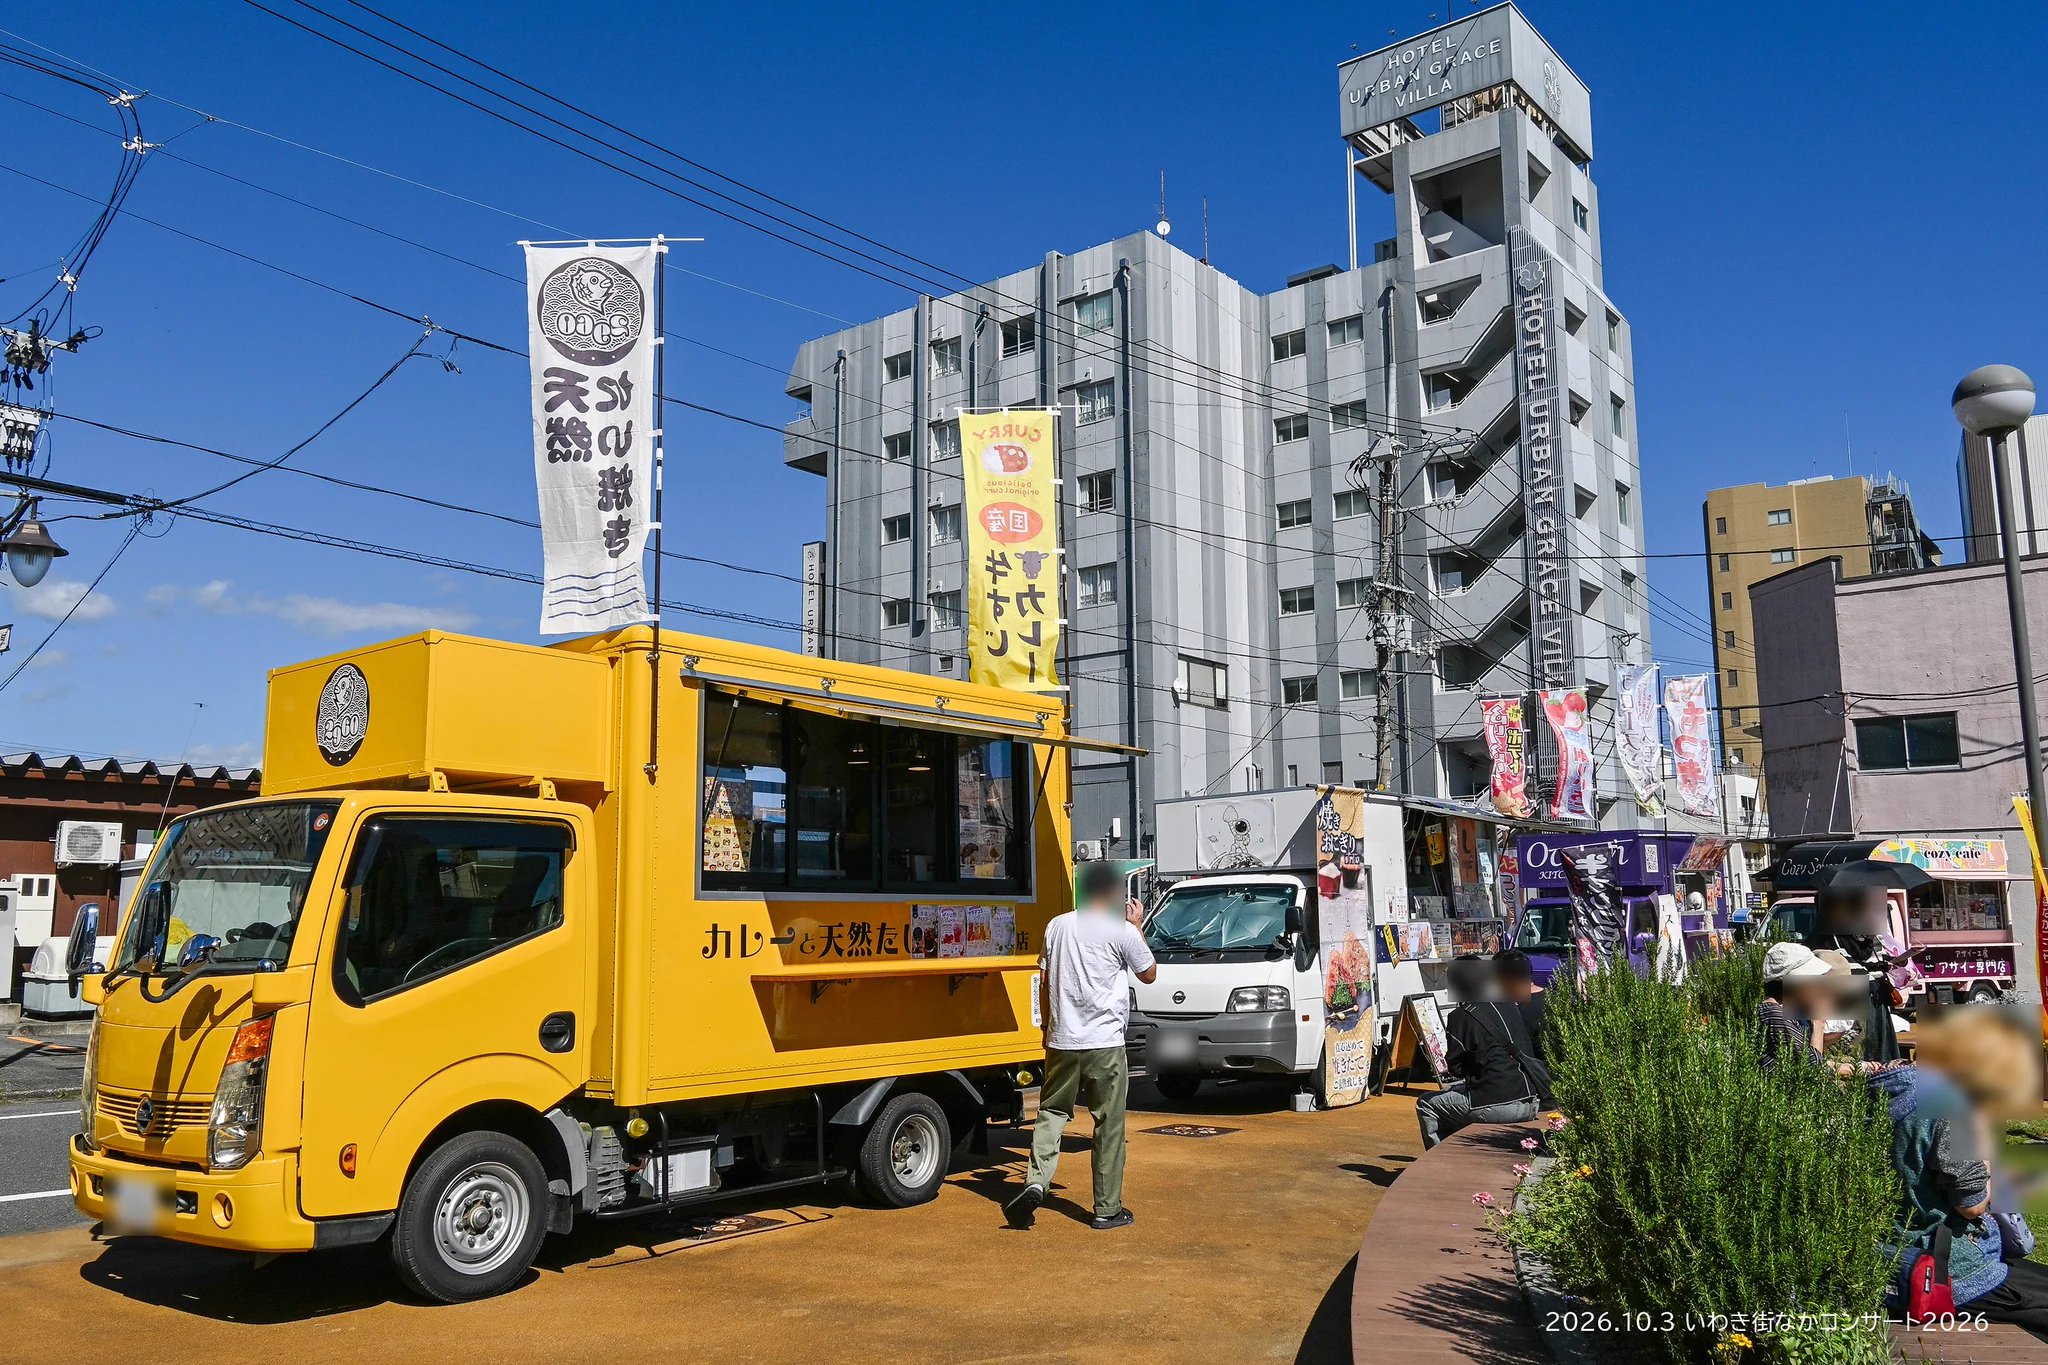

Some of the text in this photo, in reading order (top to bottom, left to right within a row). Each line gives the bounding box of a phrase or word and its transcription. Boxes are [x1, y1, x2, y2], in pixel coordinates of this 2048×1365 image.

[1387, 35, 1458, 70] HOTEL
[1349, 39, 1502, 105] URBAN GRACE
[1394, 78, 1454, 108] VILLA
[1522, 292, 1547, 391] HOTEL
[1527, 403, 1555, 504] URBAN
[1536, 516, 1561, 618] GRACE
[807, 563, 815, 605] HOTEL
[1318, 800, 1341, 831] 焼き
[1321, 832, 1356, 854] おにぎり
[1526, 842, 1629, 868] Ocn
[1924, 848, 1982, 863] cozy cafe
[1938, 958, 2007, 974] アサイー専門店
